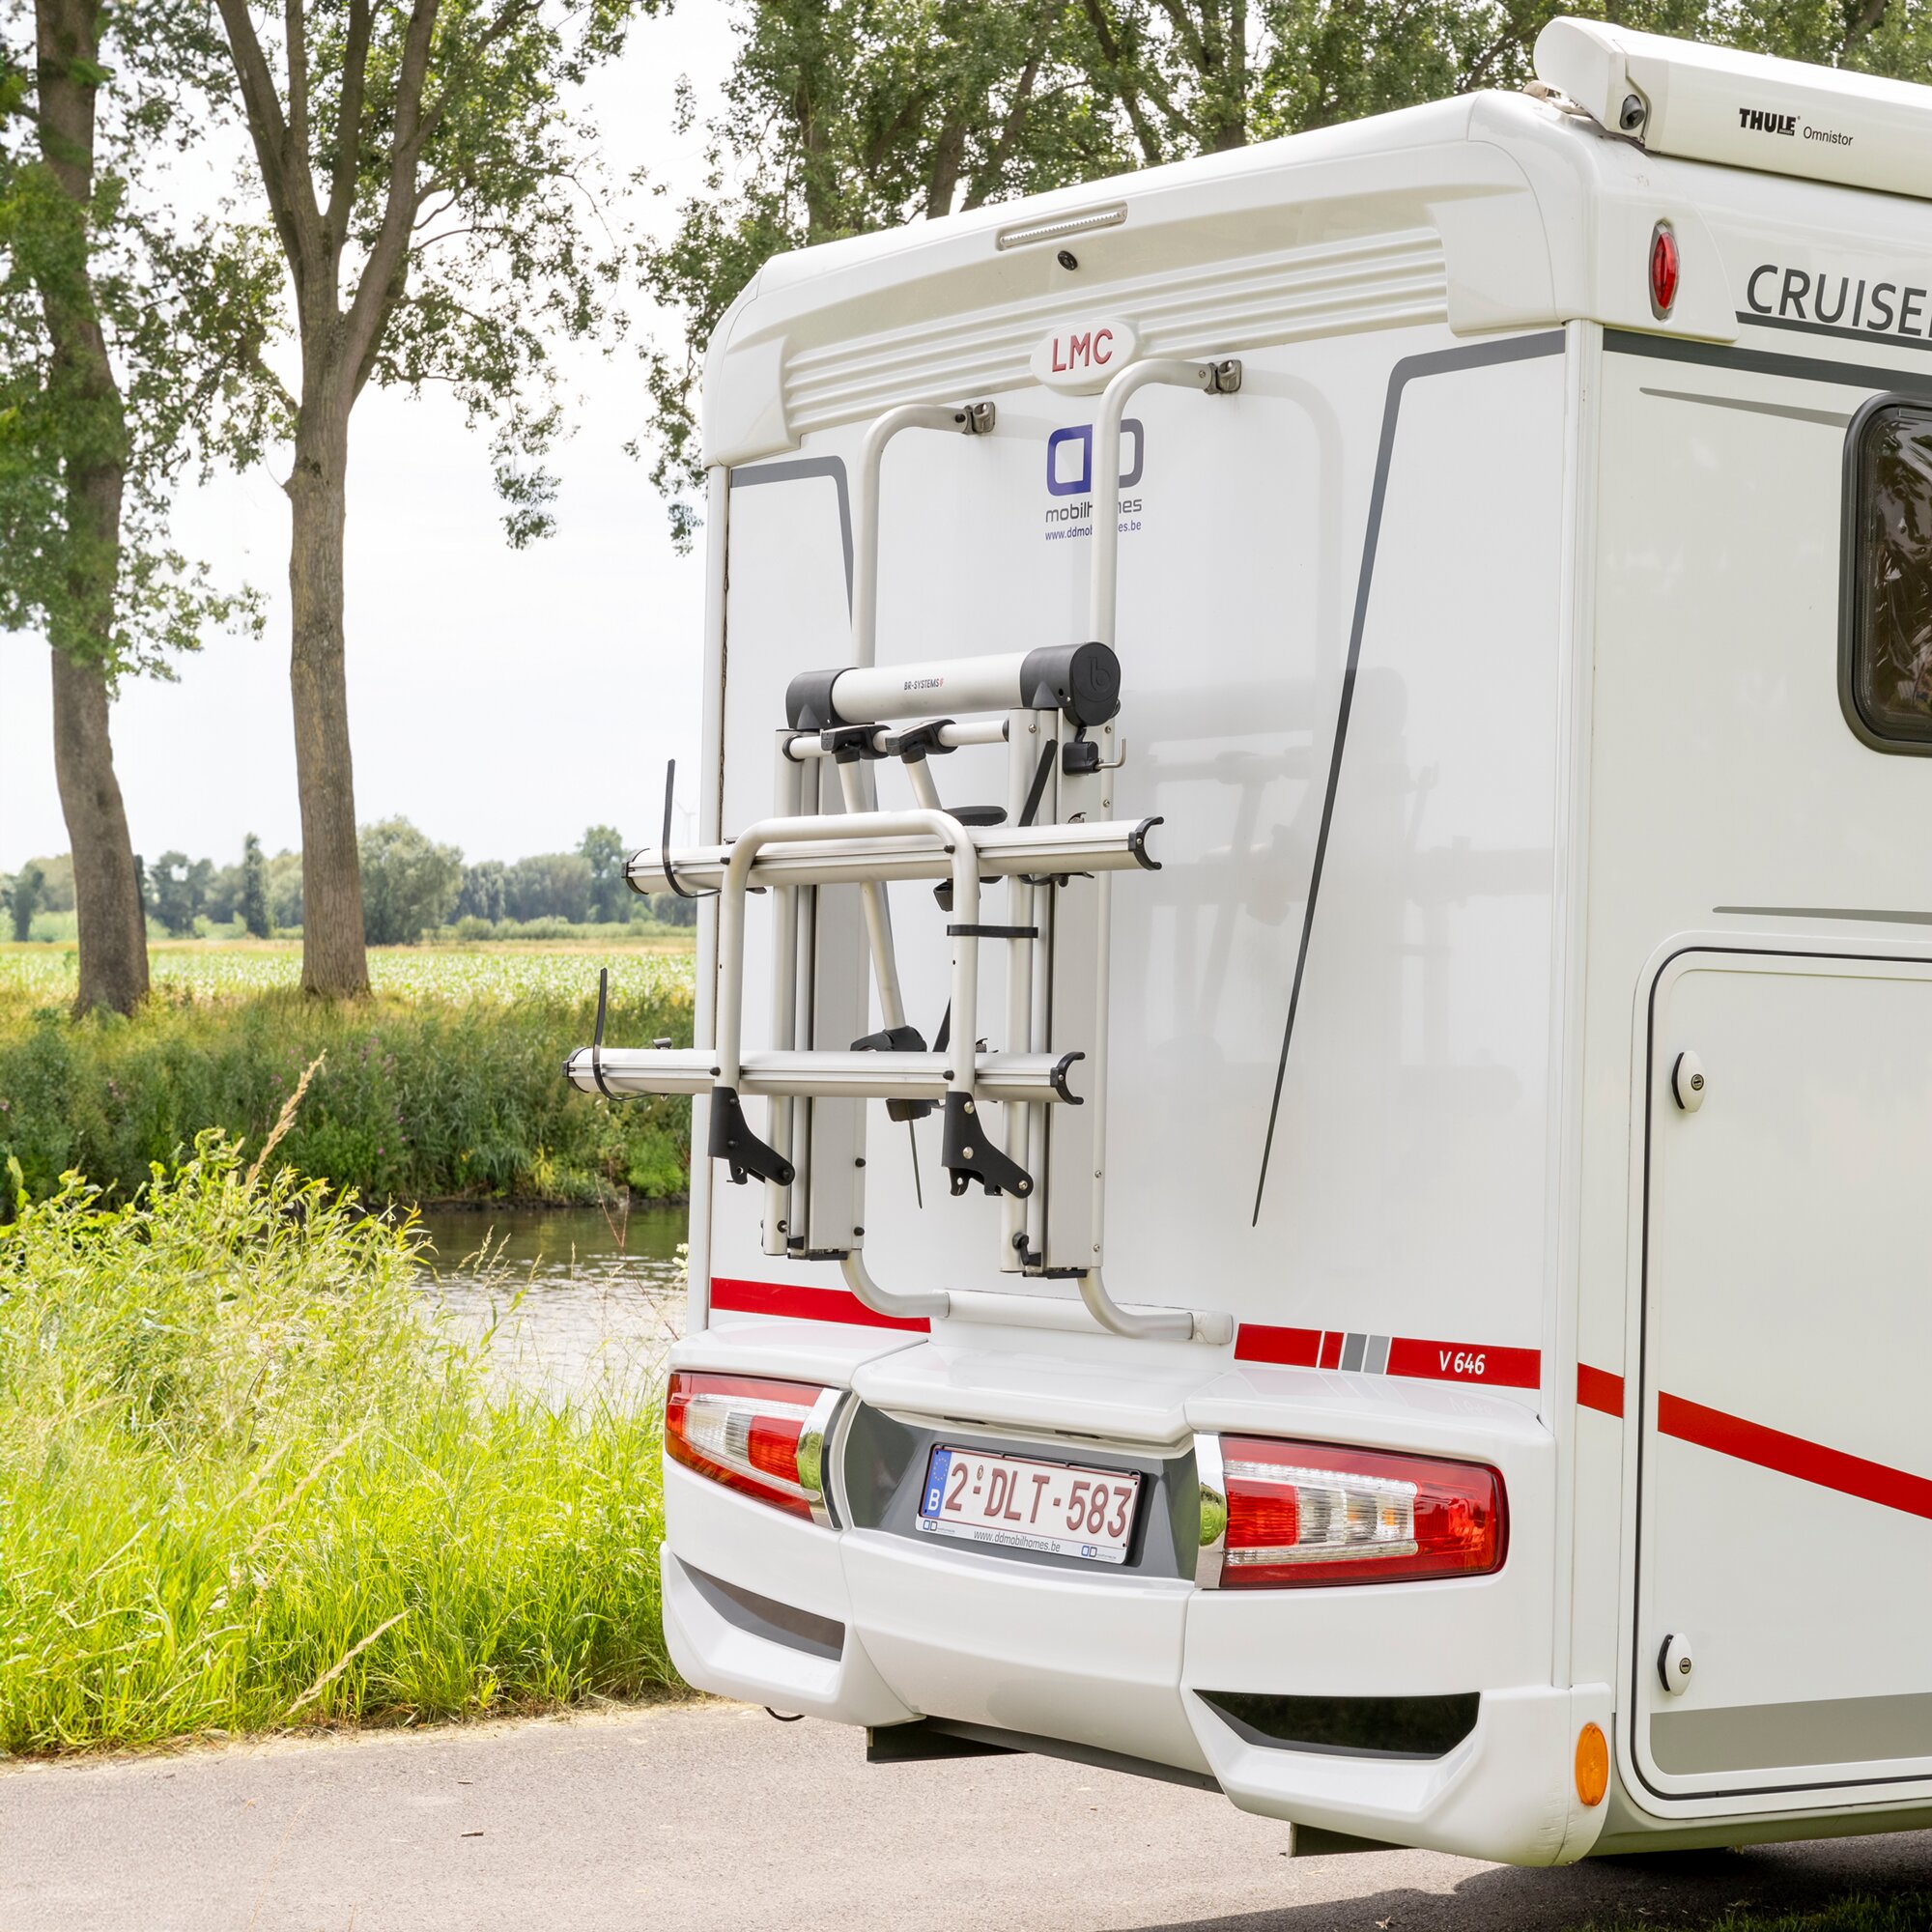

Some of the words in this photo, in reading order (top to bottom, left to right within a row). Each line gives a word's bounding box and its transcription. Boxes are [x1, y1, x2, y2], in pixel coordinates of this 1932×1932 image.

[1739, 108, 1797, 136] THULE
[1803, 126, 1854, 147] Omnistor
[1747, 264, 1932, 338] CRUISE
[1051, 327, 1114, 373] LMC
[1045, 497, 1143, 524] mobilhes
[903, 677, 940, 691] BR-SYSTEMS
[1438, 1350, 1453, 1372] V
[1453, 1351, 1487, 1376] 646
[927, 1488, 941, 1512] B
[973, 1524, 1062, 1553] www.ddmobilhomes.be
